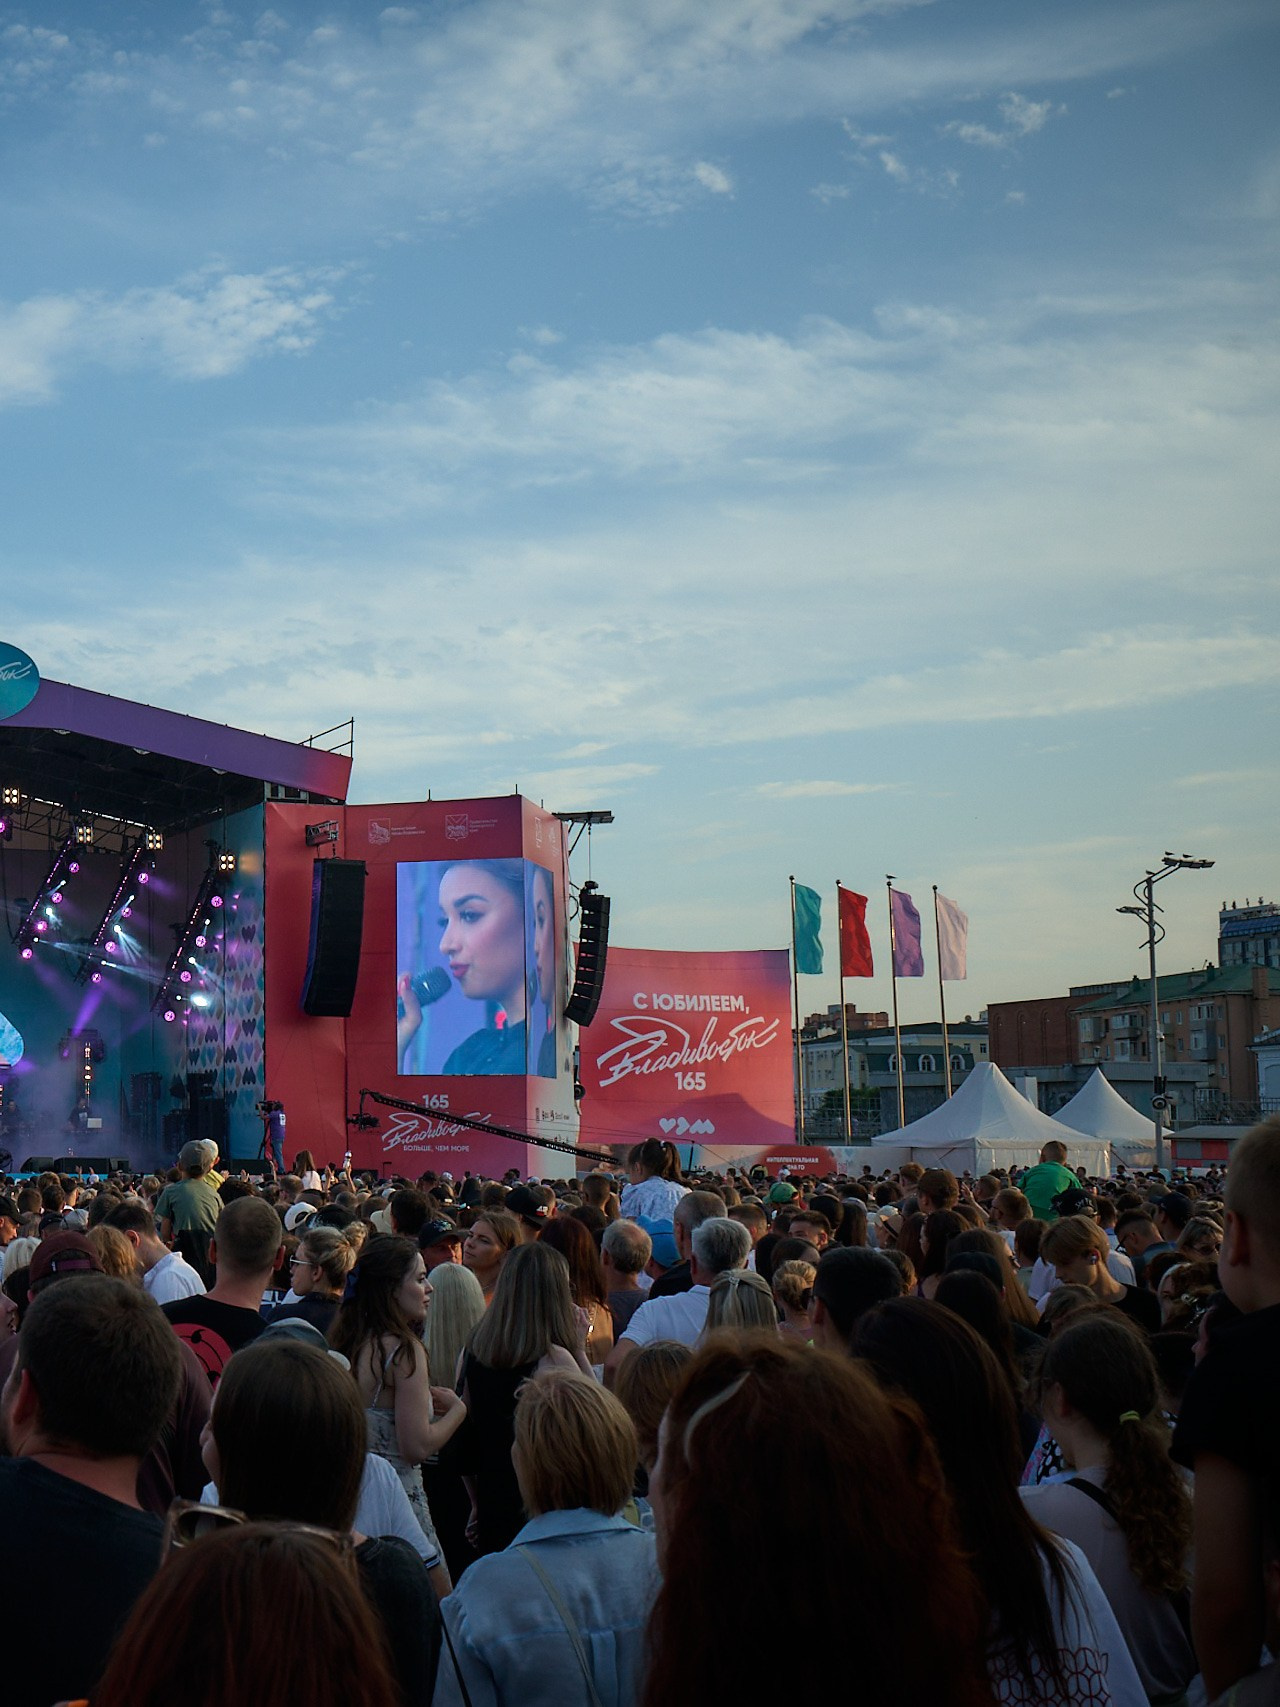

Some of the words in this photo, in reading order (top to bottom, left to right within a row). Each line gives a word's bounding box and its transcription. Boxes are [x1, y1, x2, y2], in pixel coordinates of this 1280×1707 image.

[632, 992, 649, 1010] С
[652, 992, 751, 1015] ЮБИЛЕЕМ,
[596, 1015, 780, 1088] Владивосток
[674, 1071, 707, 1091] 165
[422, 1094, 450, 1109] 165
[403, 1144, 434, 1153] БОЛЬШЕ,
[450, 1145, 470, 1153] МОРЕ
